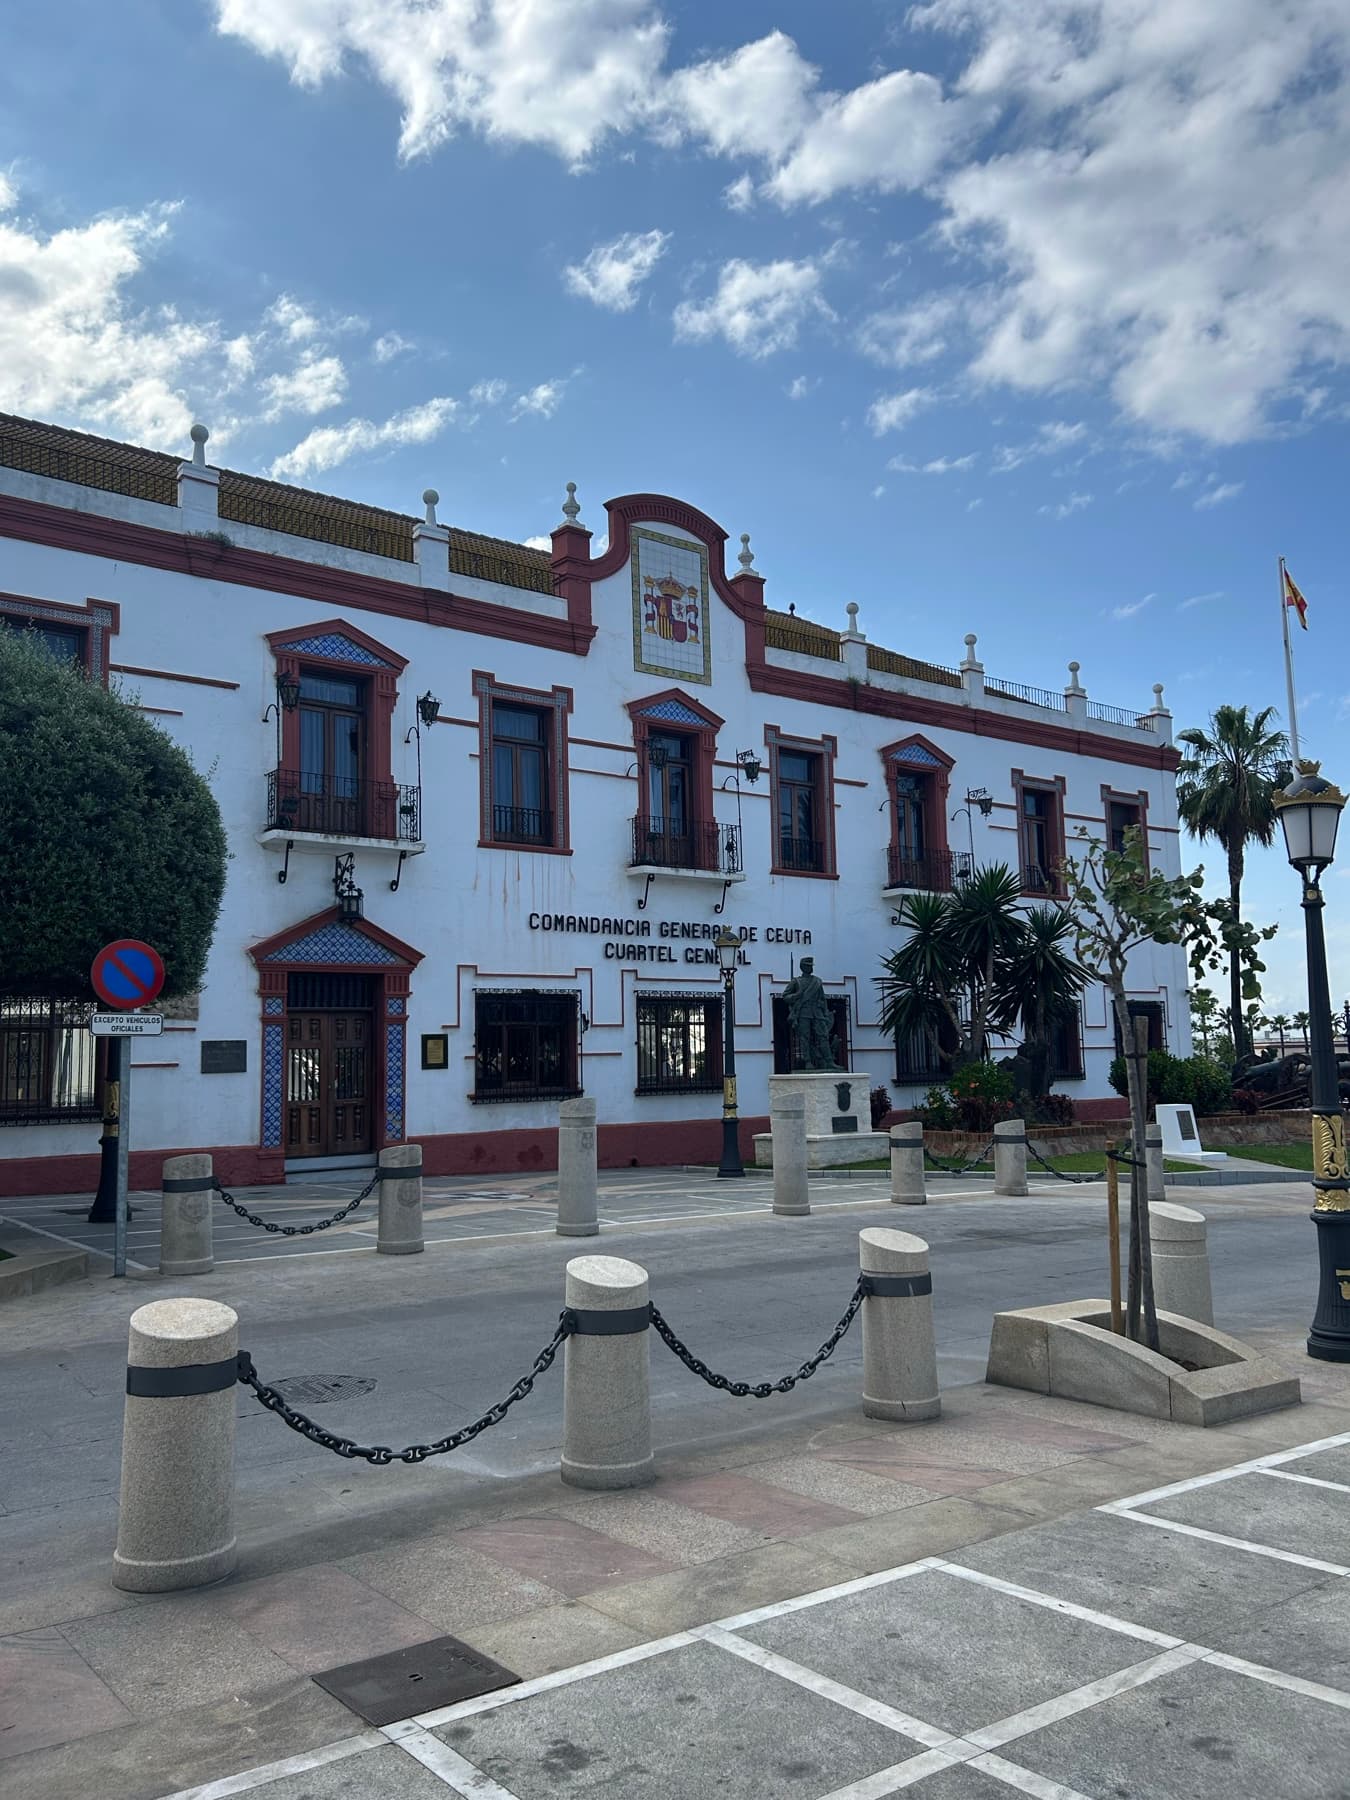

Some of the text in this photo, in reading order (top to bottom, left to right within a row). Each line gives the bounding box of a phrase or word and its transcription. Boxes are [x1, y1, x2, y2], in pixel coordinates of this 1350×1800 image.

[529, 913, 812, 945] COMANDANCIA GENERA DE CEUTA
[604, 942, 752, 965] CUARTEL GENEAL
[94, 1016, 124, 1024] EXCEPTO
